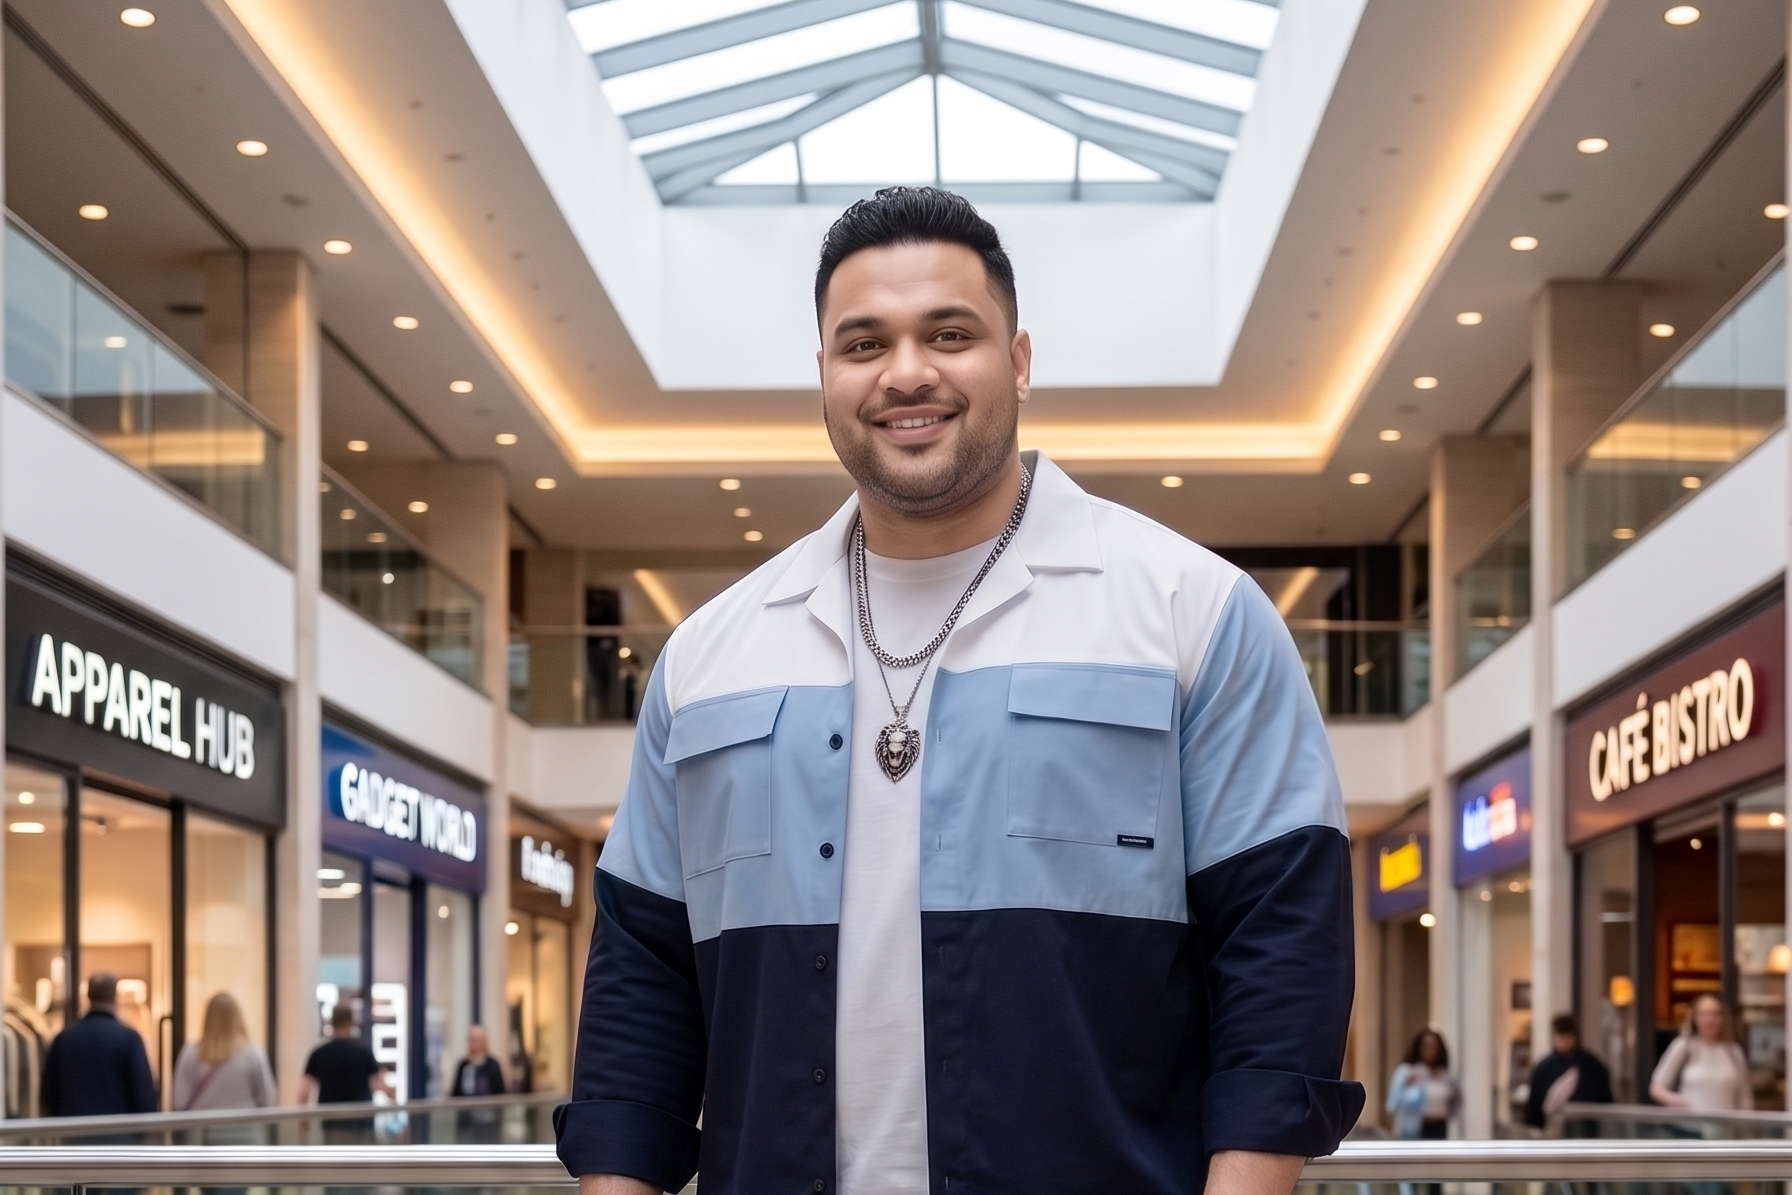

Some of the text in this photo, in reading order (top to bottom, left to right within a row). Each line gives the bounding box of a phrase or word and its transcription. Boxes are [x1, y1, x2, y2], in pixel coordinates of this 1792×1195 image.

[31, 633, 255, 780] APPAREL HUB
[1588, 657, 1754, 802] CAFÉ BISTRO
[340, 761, 477, 863] GADGET WORLD
